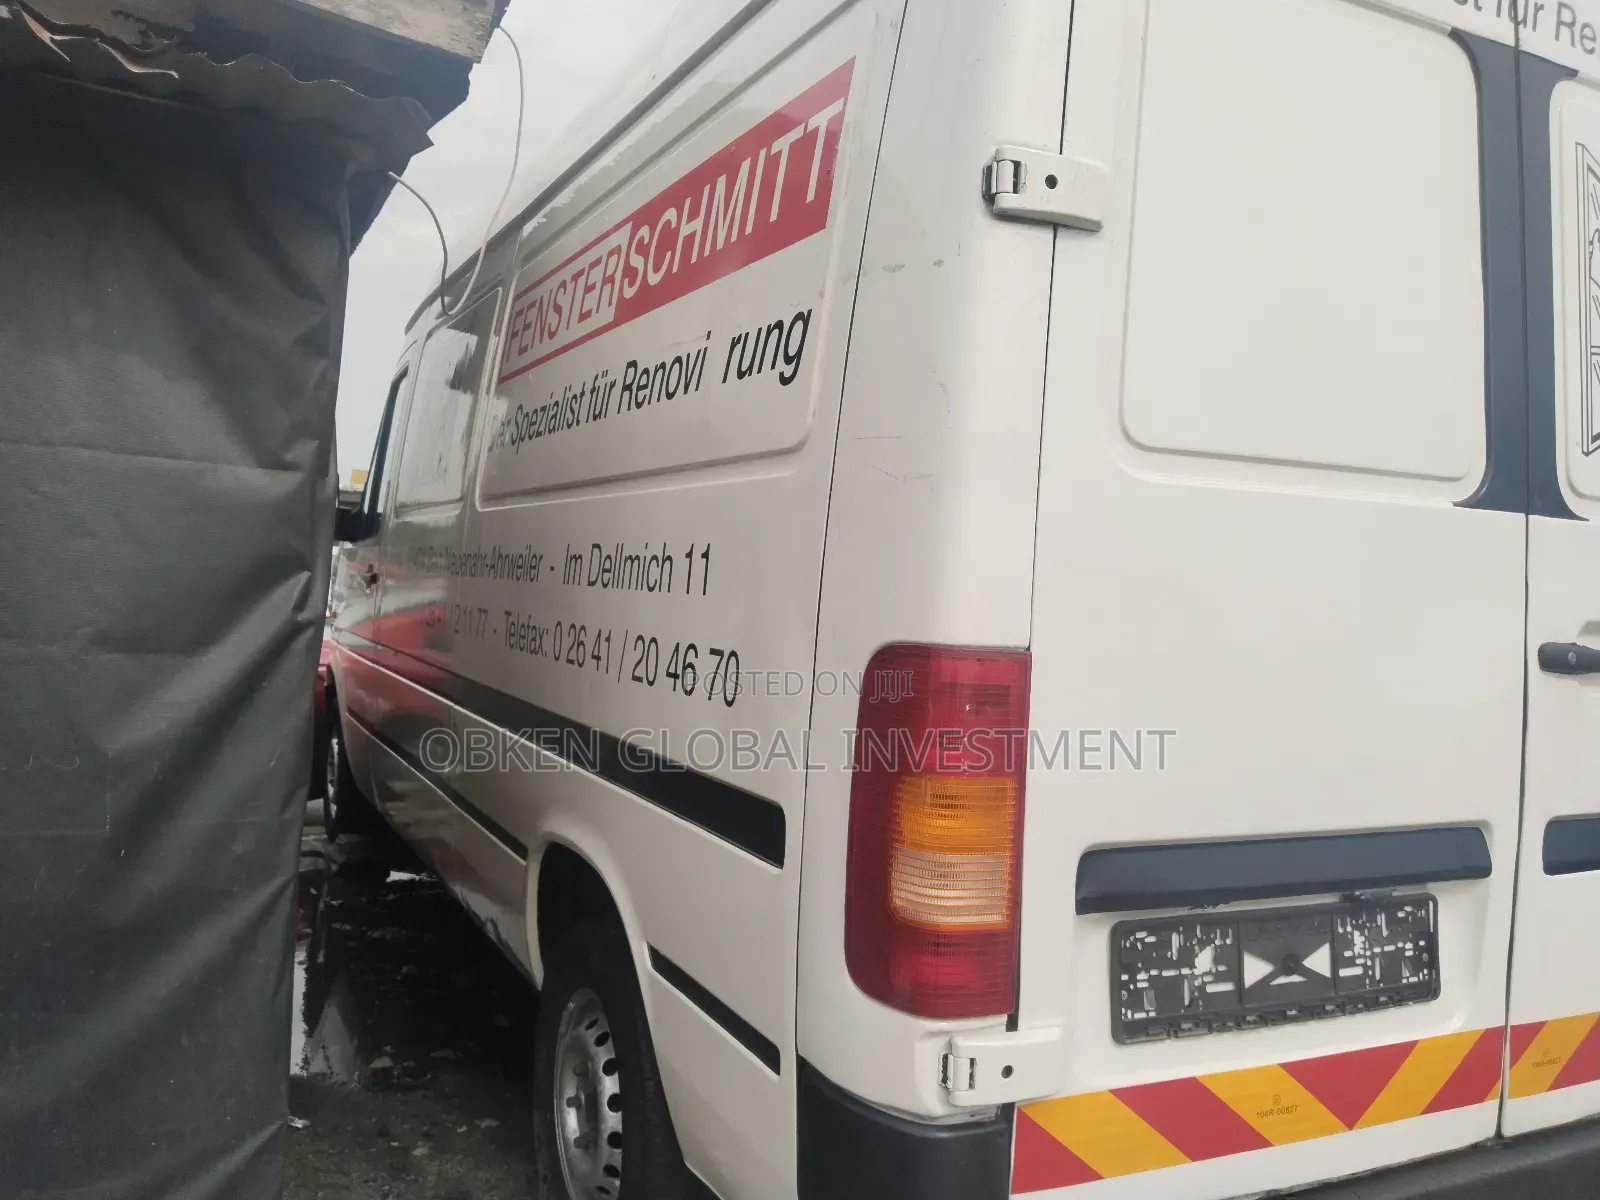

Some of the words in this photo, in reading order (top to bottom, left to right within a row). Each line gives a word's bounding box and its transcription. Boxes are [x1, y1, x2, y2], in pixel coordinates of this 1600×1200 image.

[506, 244, 622, 363] FENSTER
[622, 97, 845, 300] SCHMITT
[511, 382, 585, 455] Spezialist
[585, 369, 617, 424] für
[722, 308, 813, 386] rung
[562, 543, 583, 585] Im
[587, 542, 673, 594] Dellmich
[685, 543, 711, 596] 11
[476, 607, 489, 640] 77
[504, 611, 549, 657] Telefax:
[553, 621, 562, 662] 0
[566, 623, 586, 668] 26
[591, 628, 611, 675] 41
[617, 630, 629, 683] /
[631, 635, 659, 687] 20
[665, 641, 699, 697] 46
[708, 647, 740, 707] 70
